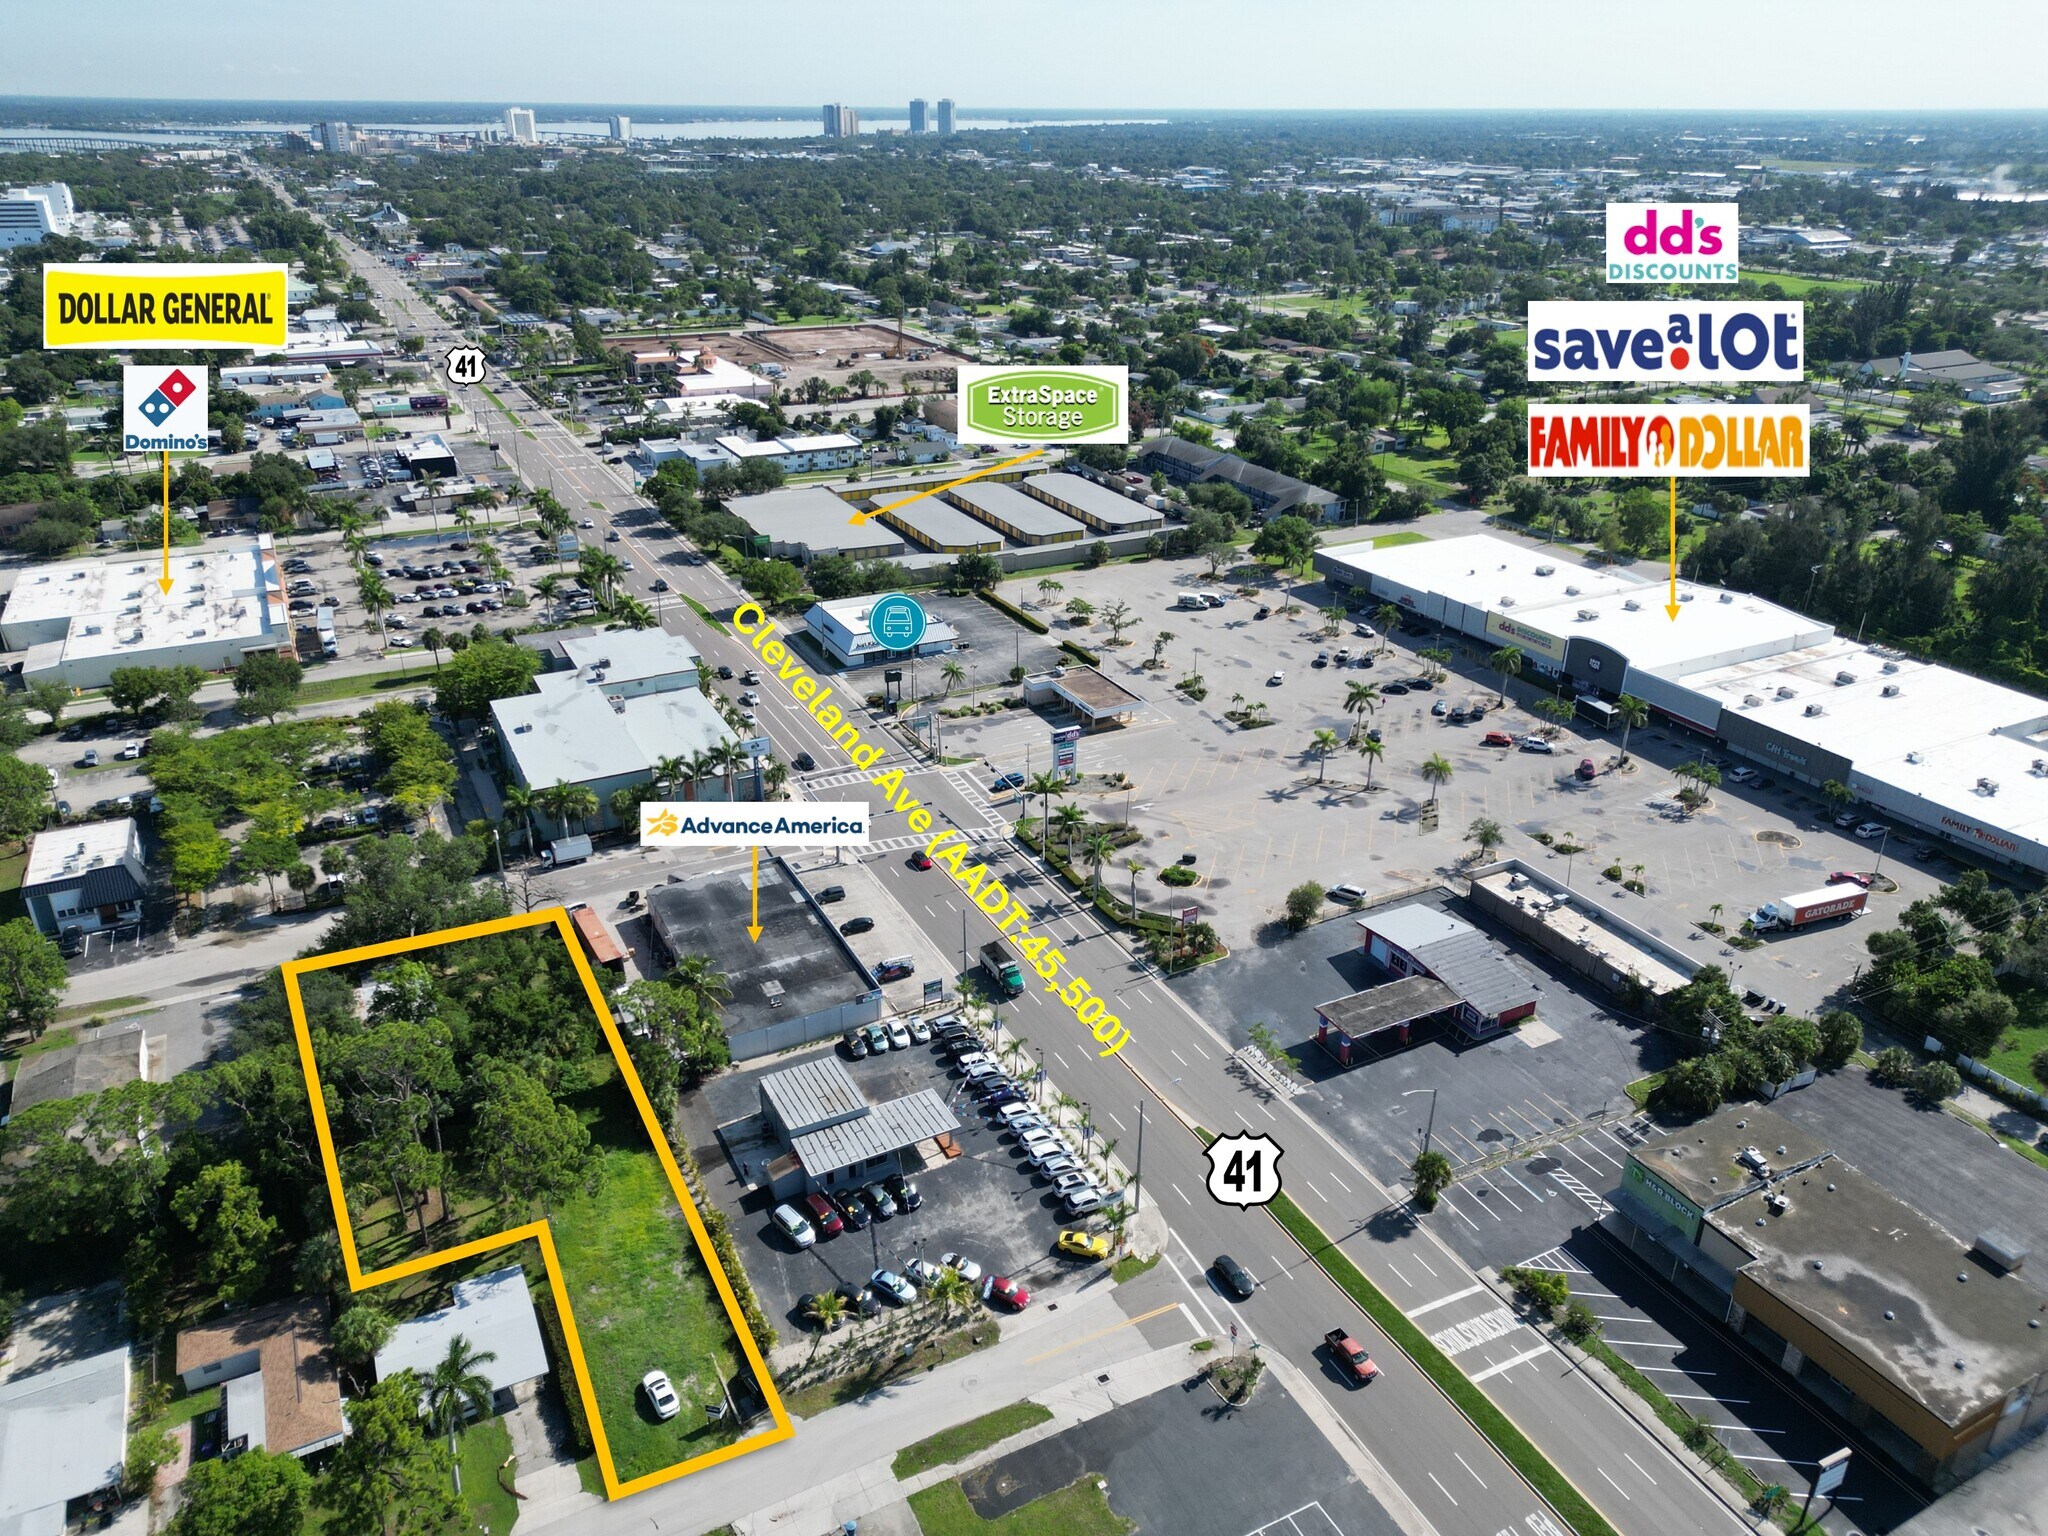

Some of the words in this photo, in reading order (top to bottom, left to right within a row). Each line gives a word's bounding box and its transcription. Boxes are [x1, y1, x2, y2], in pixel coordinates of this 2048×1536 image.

[1941, 816, 1971, 834] FAMILY
[1804, 900, 1855, 919] GATORADE
[1664, 1194, 1695, 1220] BLOCK
